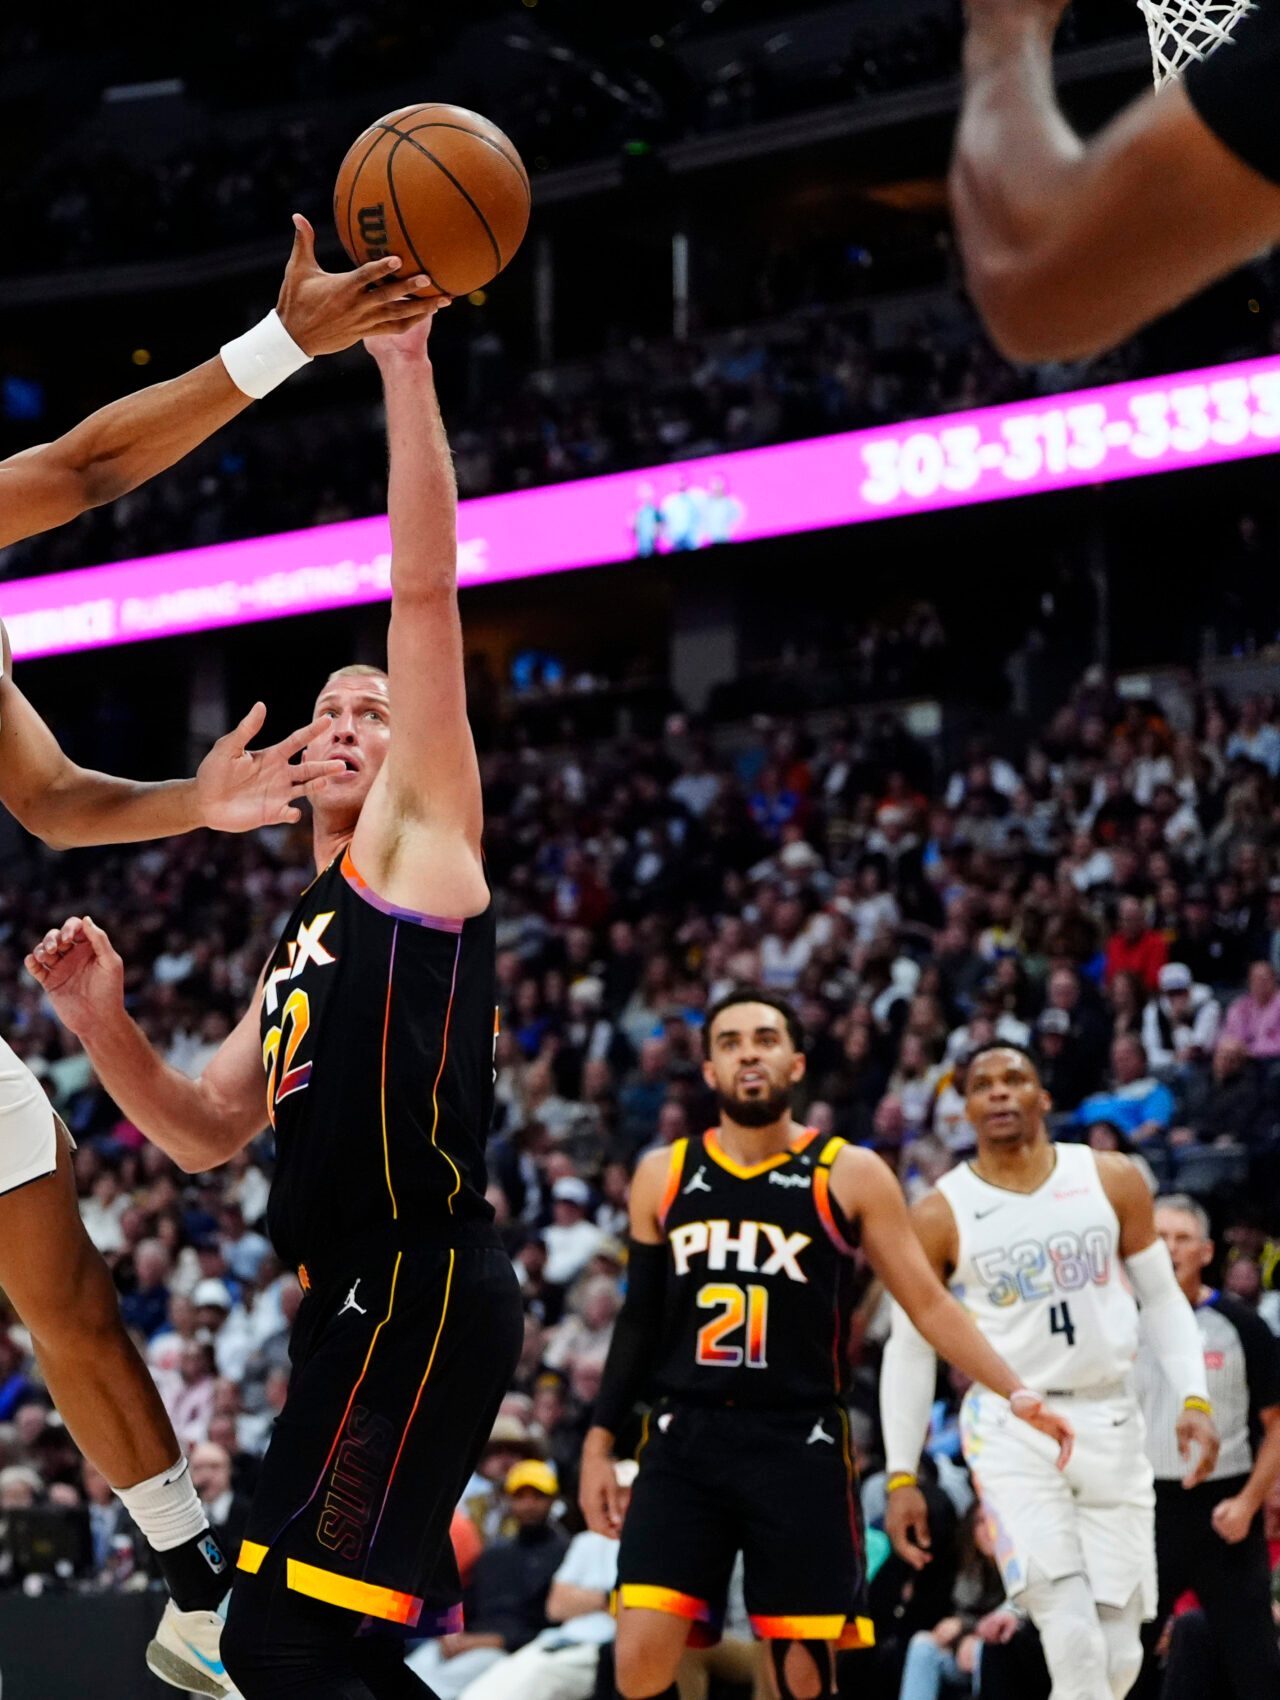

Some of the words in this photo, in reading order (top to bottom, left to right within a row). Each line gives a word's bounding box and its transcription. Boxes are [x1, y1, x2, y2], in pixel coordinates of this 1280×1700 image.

[860, 371, 1280, 505] 303-313-3333
[668, 1219, 812, 1284] PHX
[971, 1225, 1112, 1307] 5280
[696, 1282, 768, 1369] 21
[1050, 1300, 1075, 1346] 4
